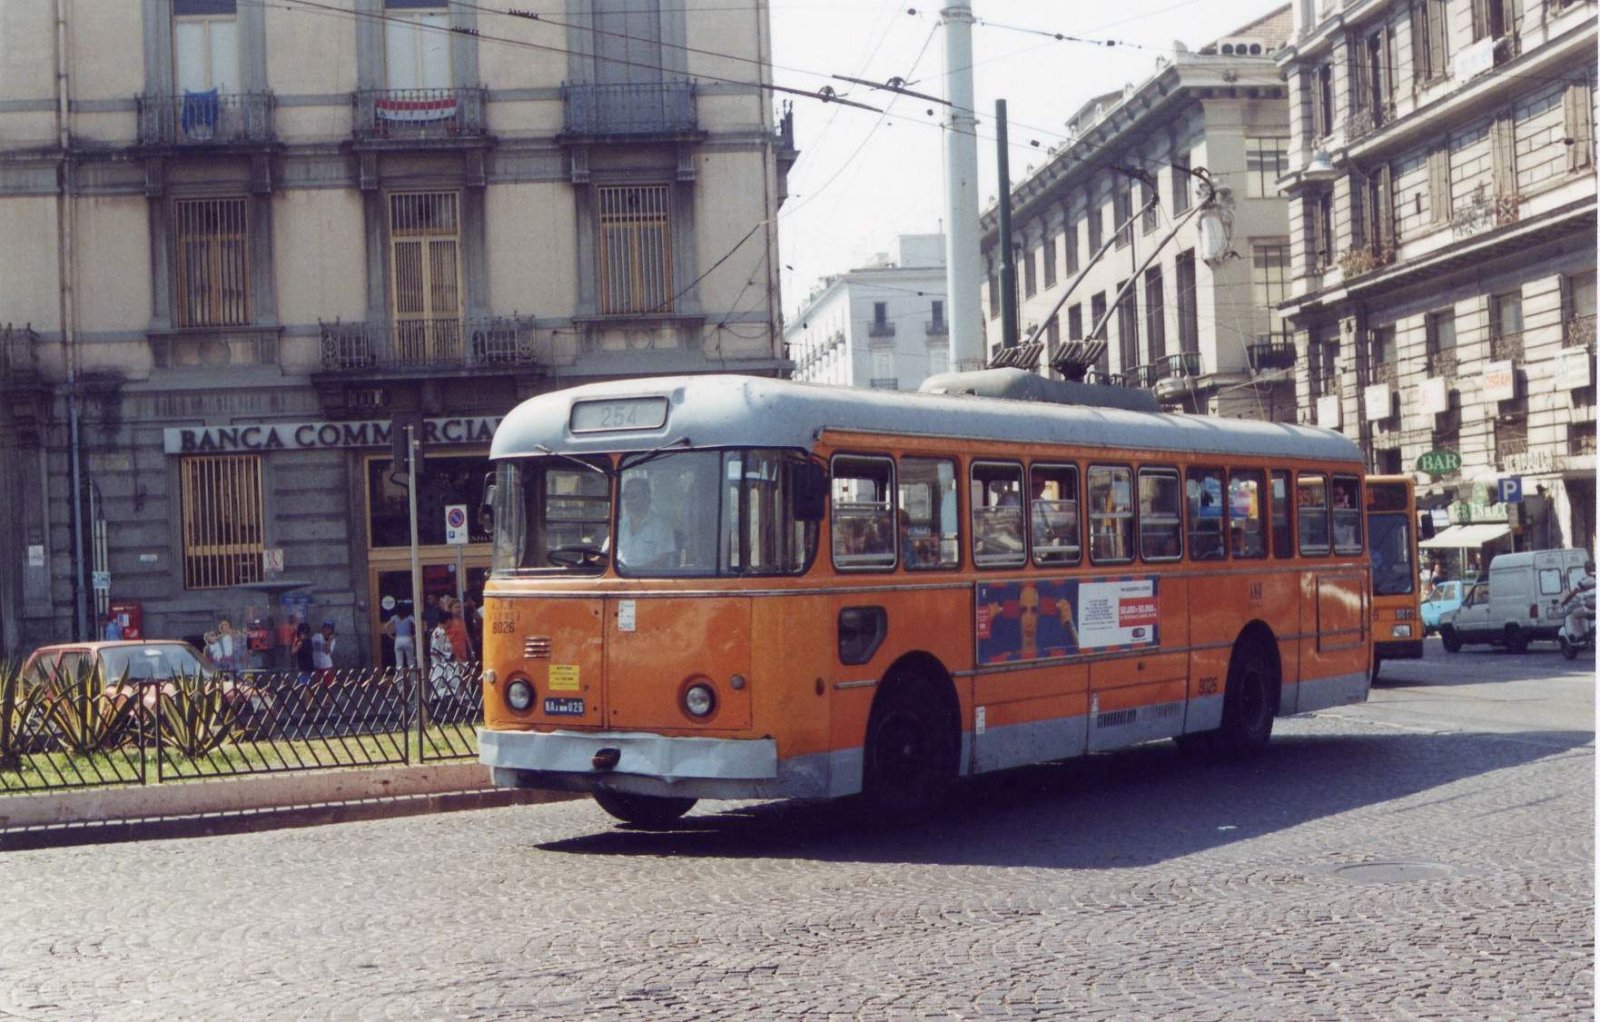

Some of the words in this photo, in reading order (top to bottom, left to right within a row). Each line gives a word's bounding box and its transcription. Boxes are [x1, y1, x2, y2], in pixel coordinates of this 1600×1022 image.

[600, 404, 637, 427] 254
[179, 427, 285, 451] BANCA
[294, 417, 503, 447] COMMRCIA
[1422, 454, 1458, 471] BAR
[1503, 480, 1518, 500] P
[493, 621, 515, 634] 8026
